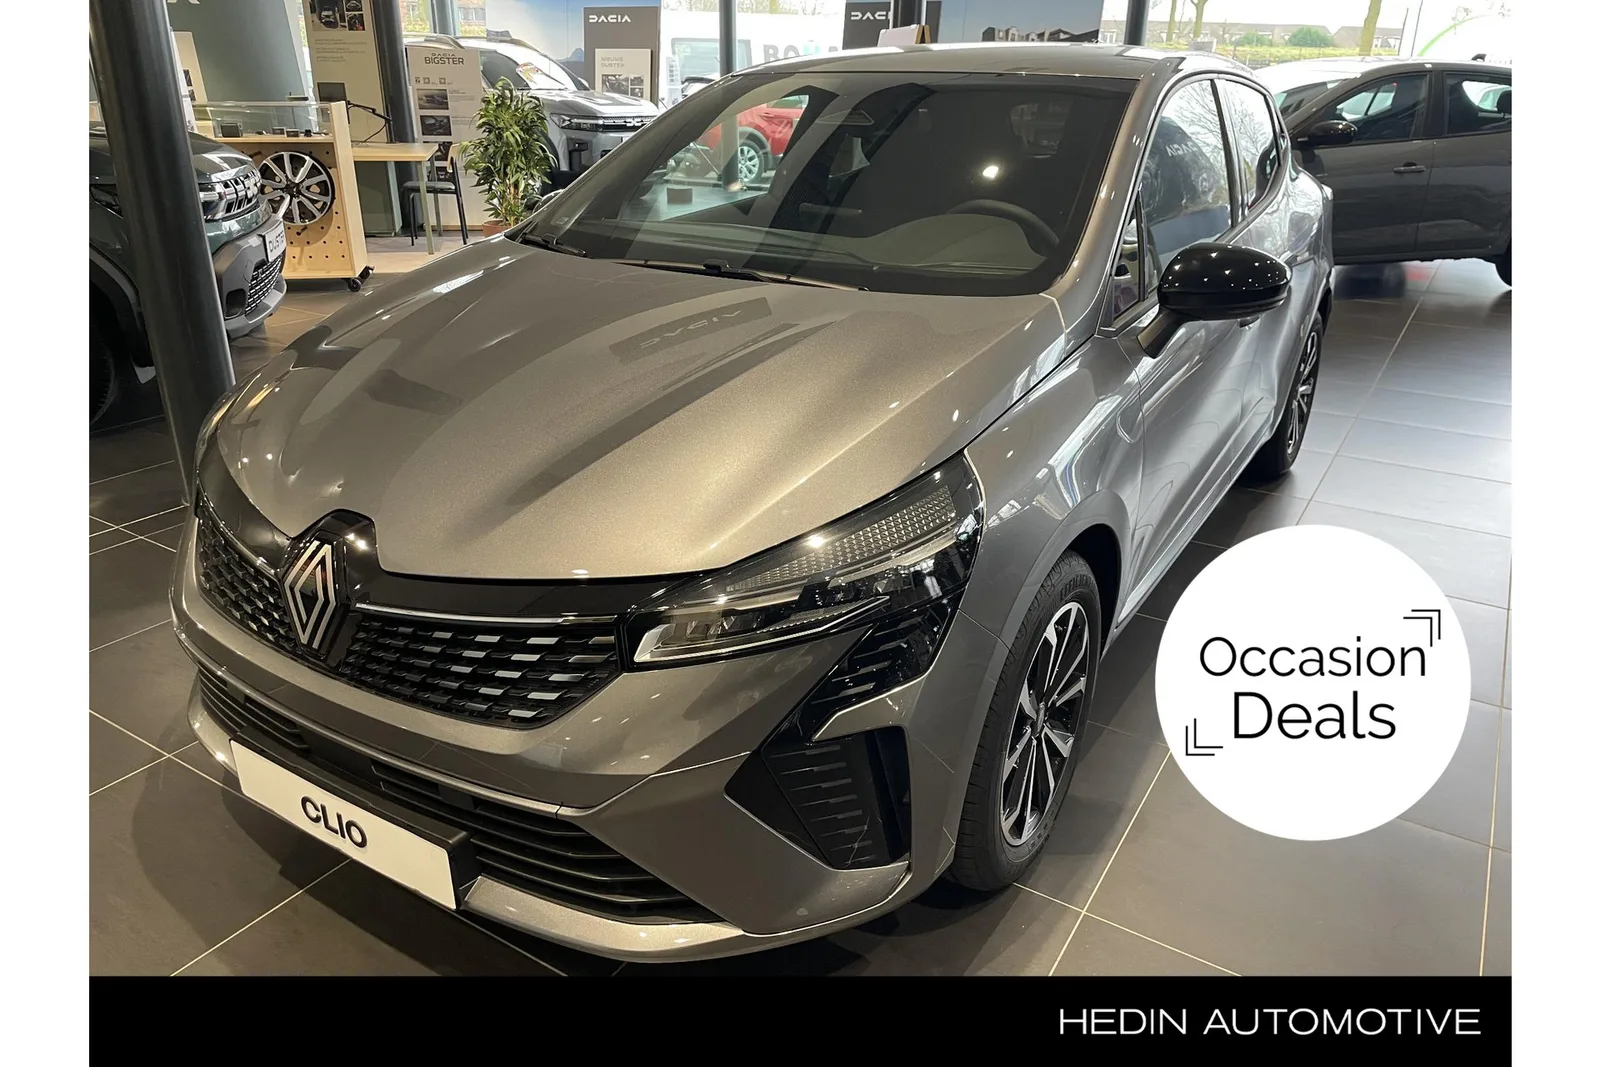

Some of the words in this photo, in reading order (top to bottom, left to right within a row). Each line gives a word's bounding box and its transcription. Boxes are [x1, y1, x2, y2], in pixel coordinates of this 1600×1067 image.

[588, 14, 632, 23] DACIA
[424, 56, 465, 65] BIGSTER
[300, 795, 368, 849] CLIO
